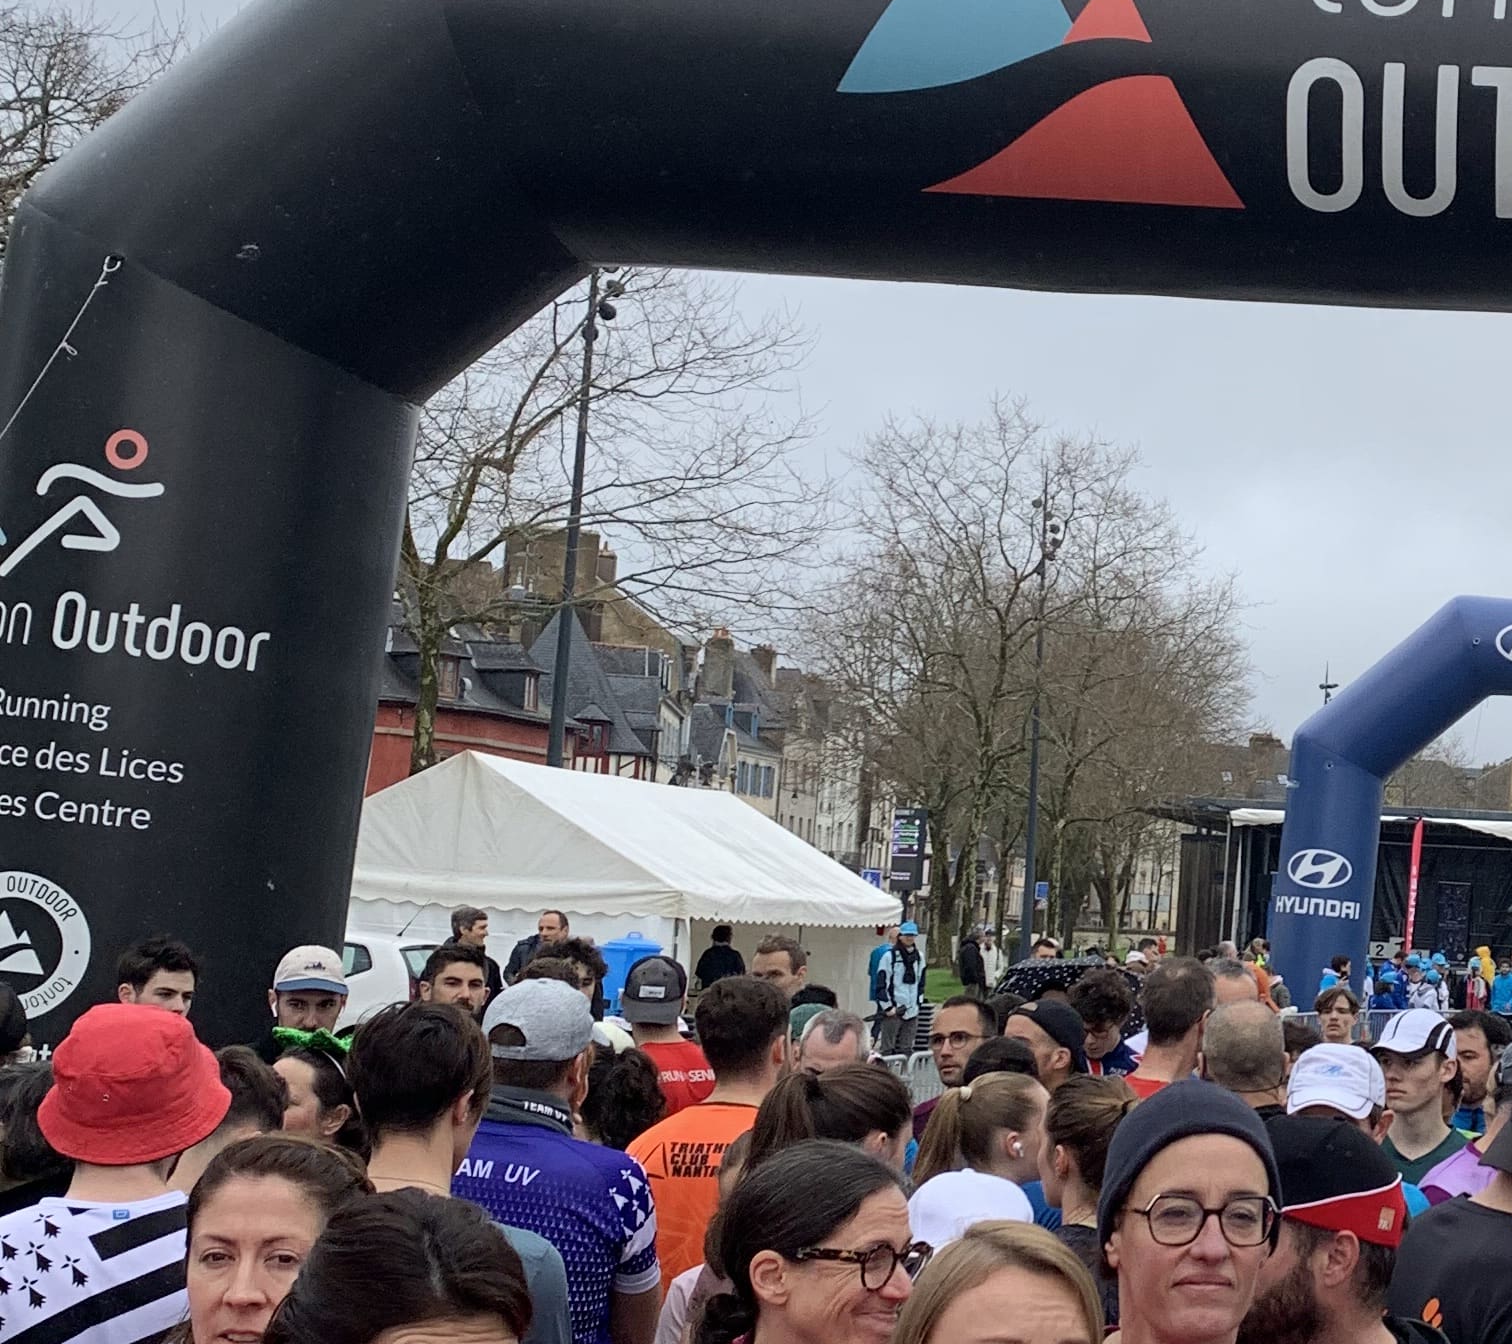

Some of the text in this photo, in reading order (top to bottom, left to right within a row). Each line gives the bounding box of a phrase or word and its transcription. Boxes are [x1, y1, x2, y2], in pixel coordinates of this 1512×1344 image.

[52, 590, 271, 672] Outdoor
[35, 741, 91, 773] des
[99, 747, 185, 784] Lices
[34, 791, 152, 830] Centre
[7, 875, 78, 923] OUTDOOR
[1274, 895, 1361, 920] HYUNDAI
[1374, 943, 1386, 957] 2
[523, 1100, 554, 1116] TEAM
[455, 1158, 541, 1186] AM UV
[670, 1153, 709, 1166] CLUB
